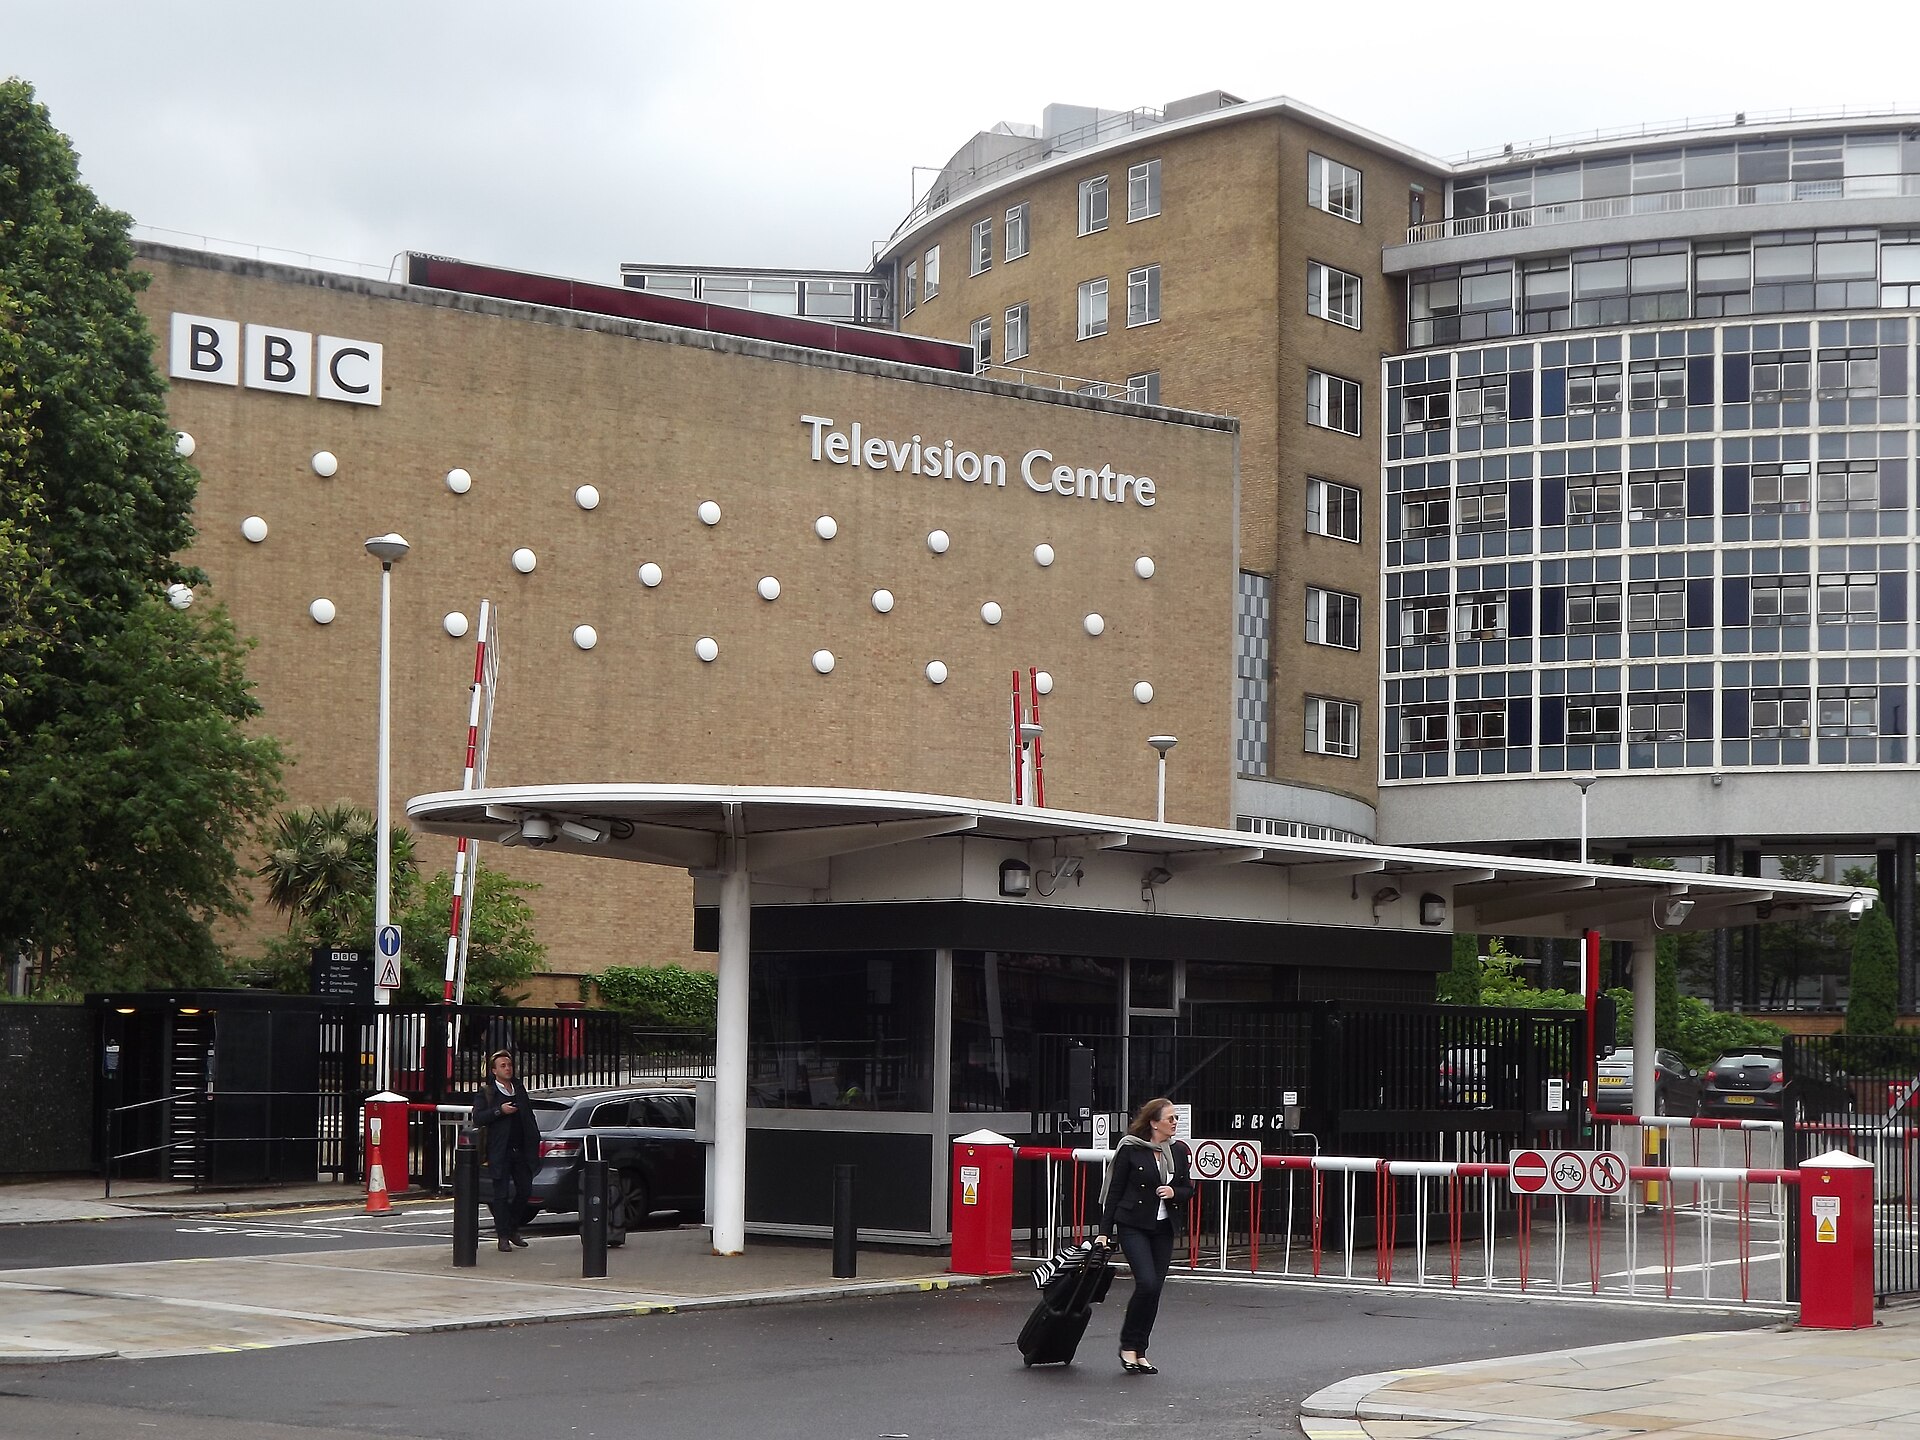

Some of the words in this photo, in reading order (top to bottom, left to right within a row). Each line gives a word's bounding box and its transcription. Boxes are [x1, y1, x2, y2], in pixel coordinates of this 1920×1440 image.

[189, 323, 371, 394] BBC
[800, 414, 1006, 487] Television
[1020, 449, 1157, 507] Centre
[332, 953, 358, 961] BBC
[1231, 1114, 1284, 1129] BBC
